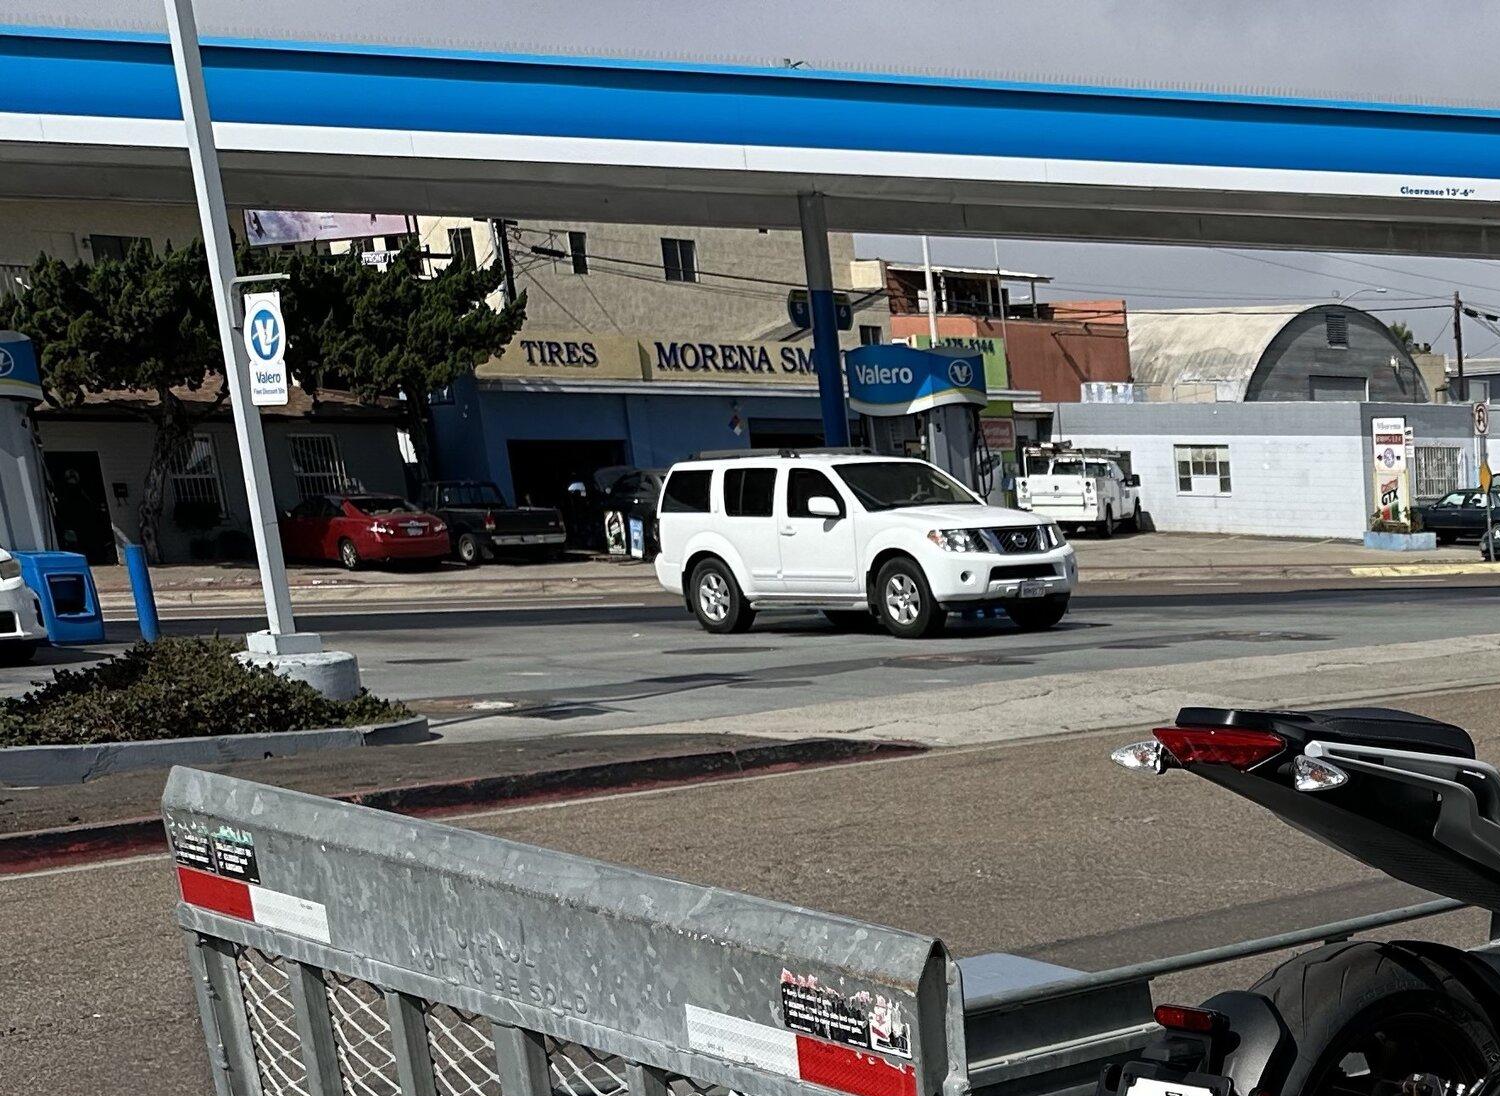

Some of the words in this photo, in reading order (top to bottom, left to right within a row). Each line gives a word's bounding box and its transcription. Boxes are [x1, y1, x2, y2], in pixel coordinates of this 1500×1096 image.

[1400, 186, 1444, 196] Clearance
[520, 339, 599, 367] TIRES
[654, 341, 776, 374] MORENA
[256, 371, 282, 384] Valero
[854, 364, 914, 386] Valero
[1381, 488, 1399, 506] GTX
[493, 969, 521, 1000] BE
[528, 976, 588, 1015] SOLD
